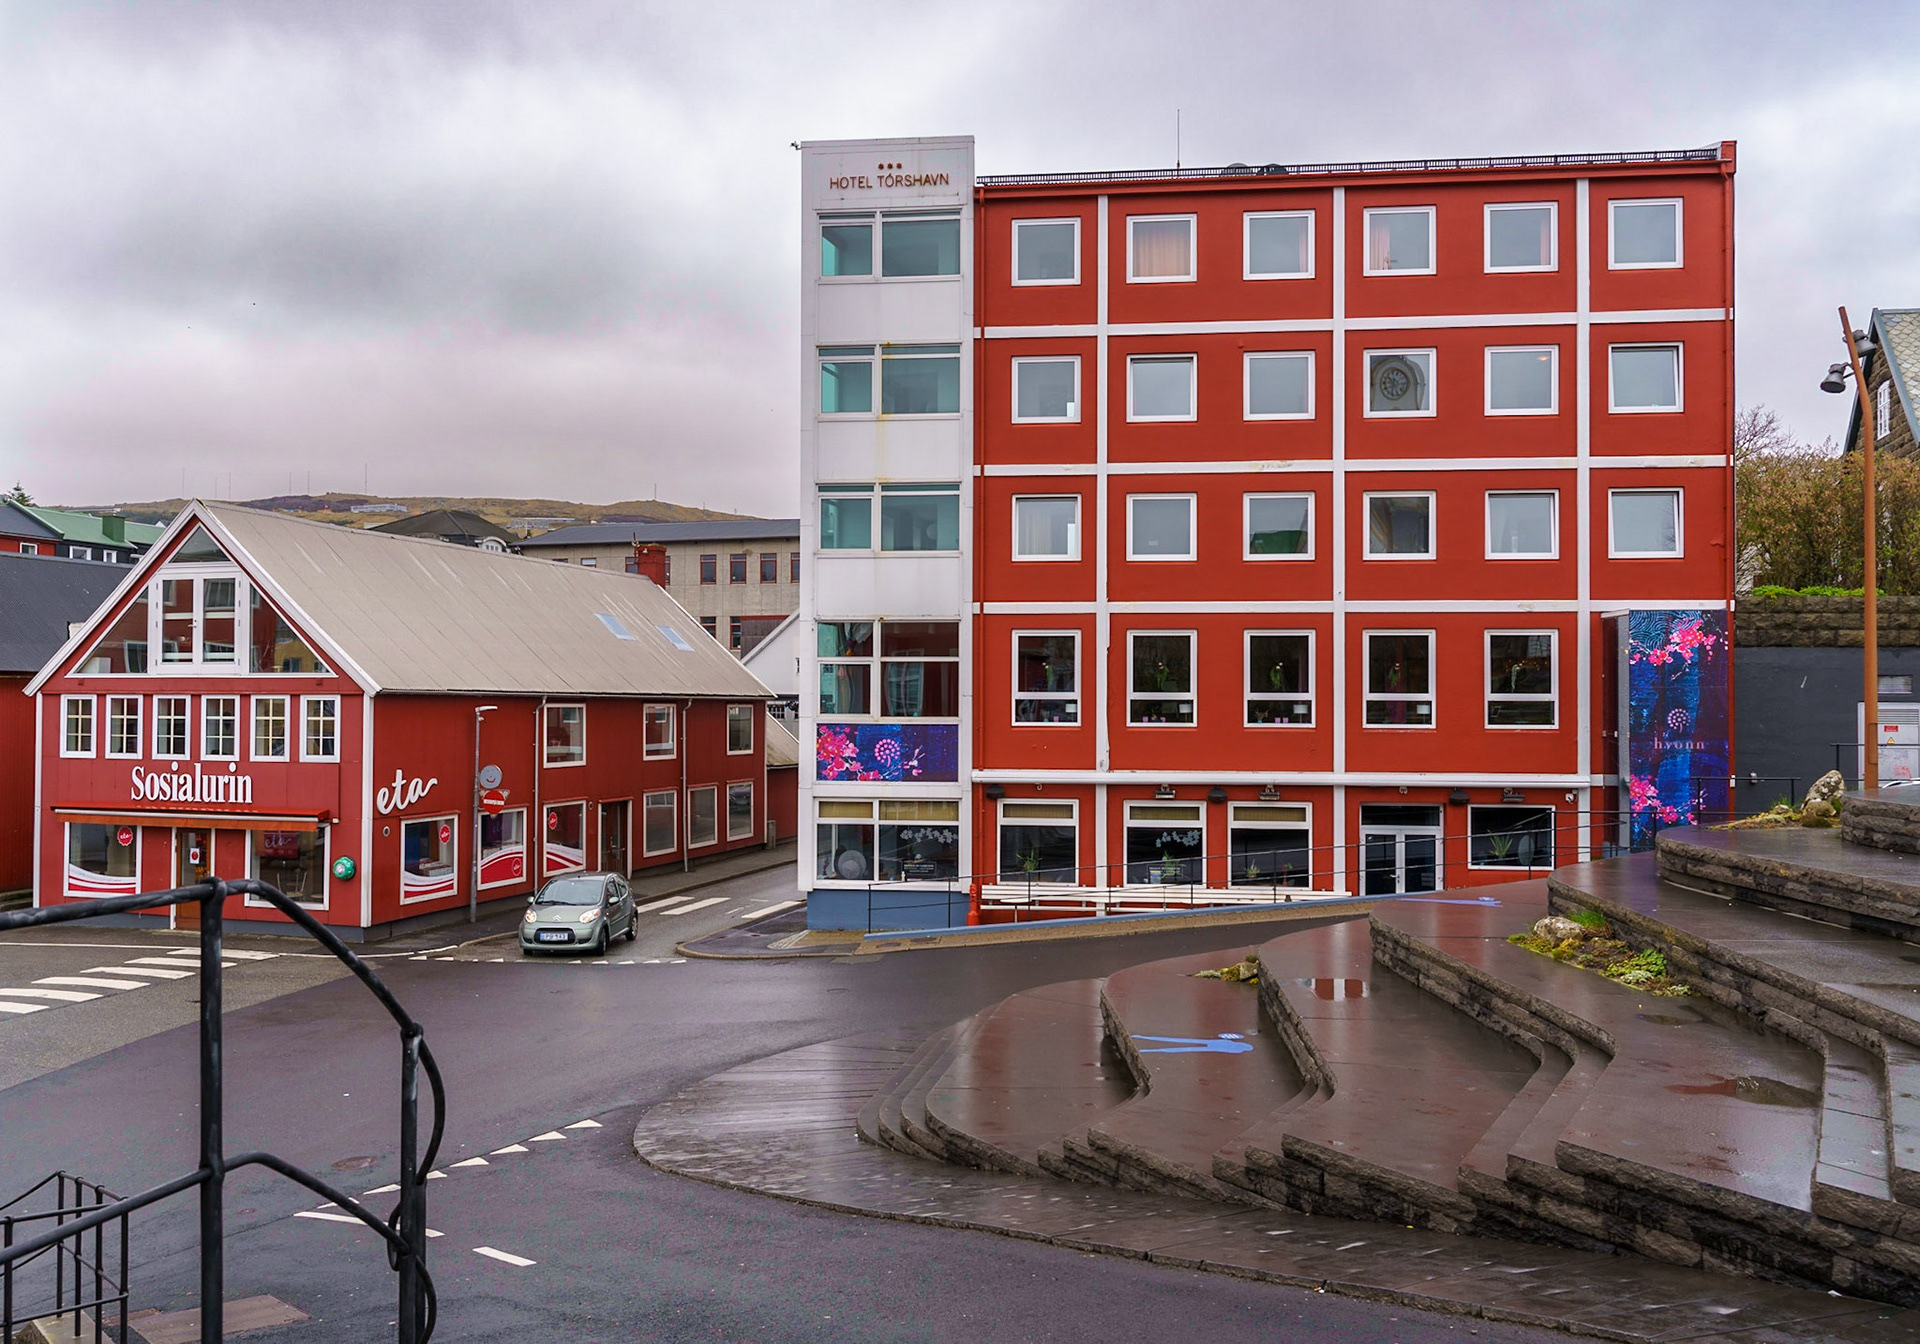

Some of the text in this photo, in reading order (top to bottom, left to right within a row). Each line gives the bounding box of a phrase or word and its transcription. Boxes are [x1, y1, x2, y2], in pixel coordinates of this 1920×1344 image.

[829, 172, 950, 190] HOTEL TÓRSHAVN
[130, 760, 254, 805] Sosialurin
[376, 768, 439, 816] eta
